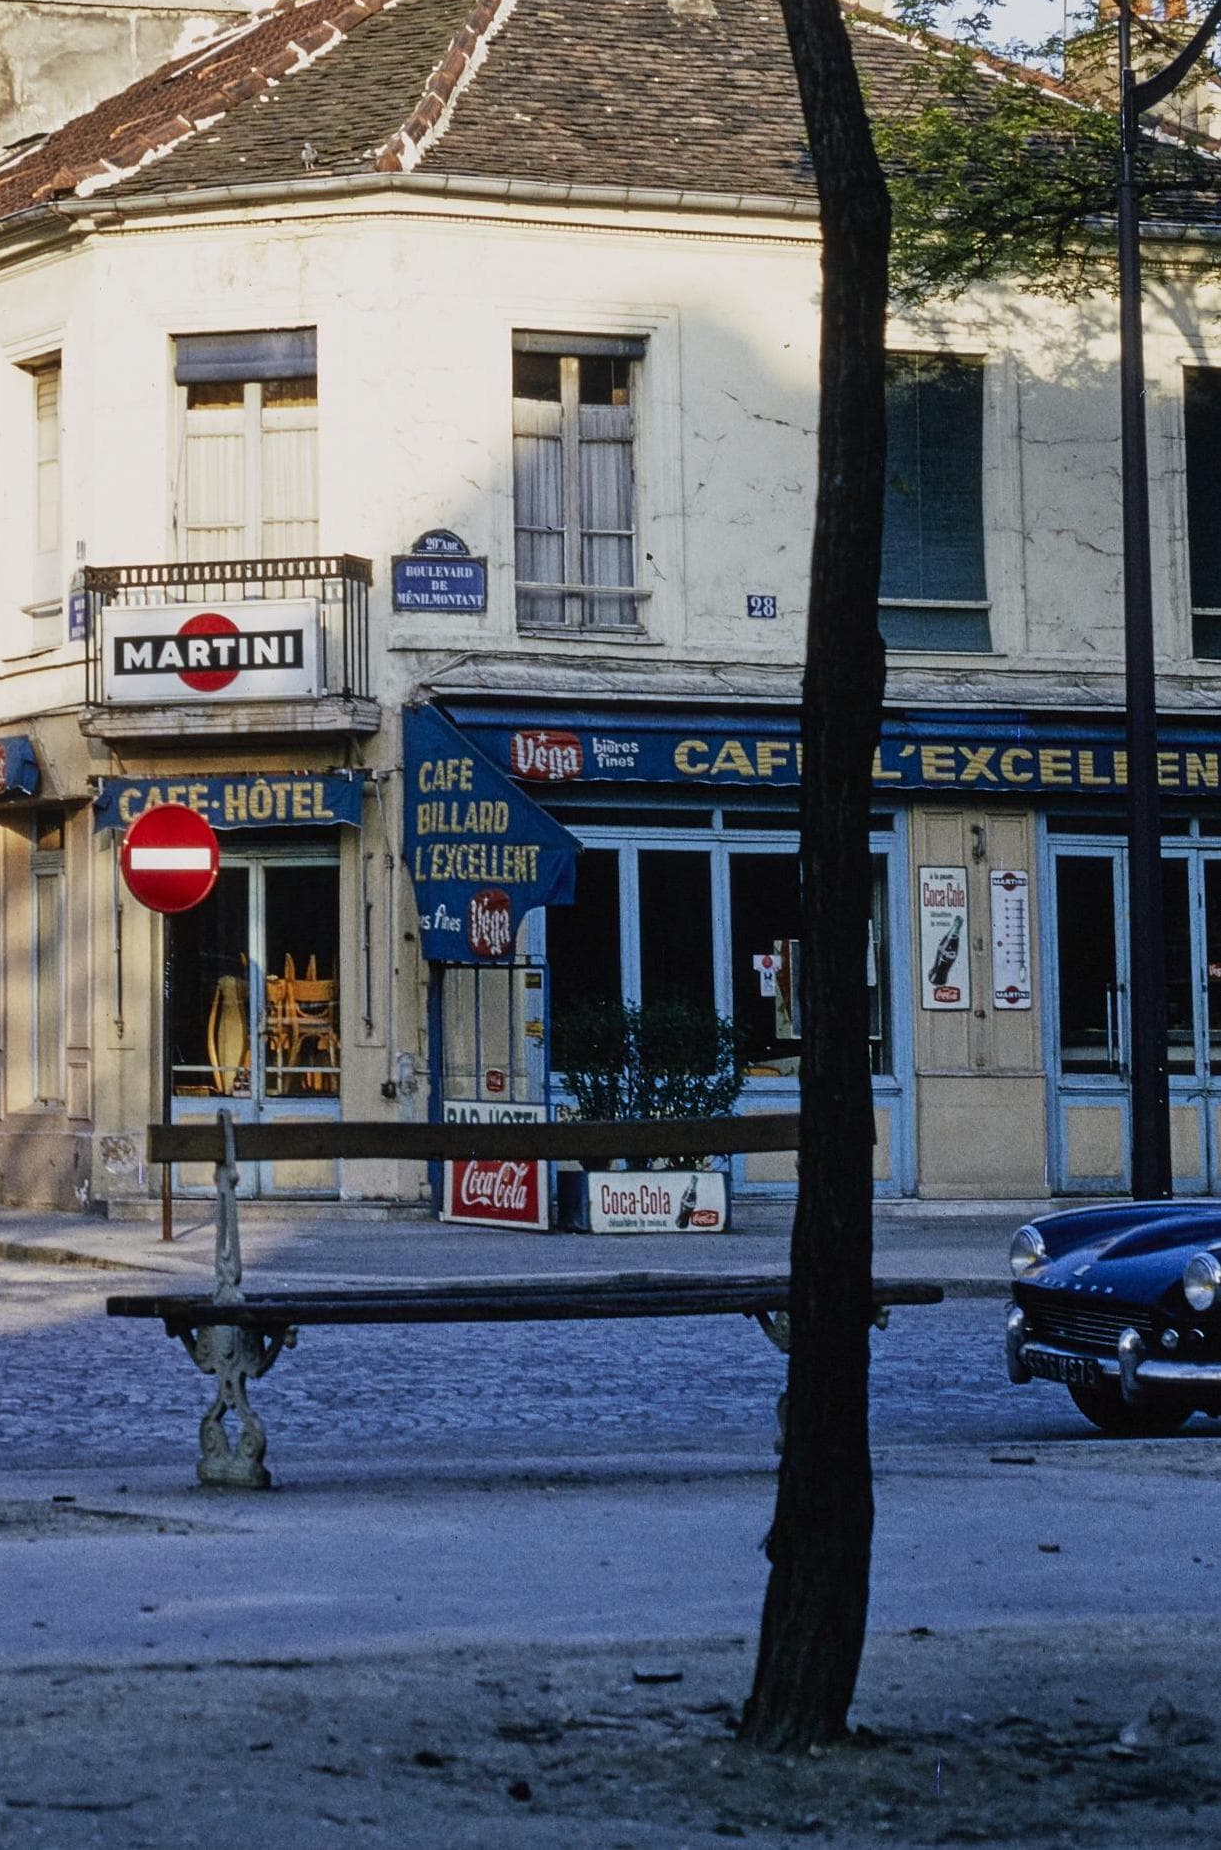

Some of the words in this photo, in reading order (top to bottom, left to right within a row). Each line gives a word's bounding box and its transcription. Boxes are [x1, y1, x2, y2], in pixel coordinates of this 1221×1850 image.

[405, 565, 473, 578] BOULEVARD
[431, 580, 448, 591] DE
[397, 590, 484, 606] MÉNILMONTANT
[750, 596, 774, 617] 28
[123, 636, 294, 670] MARTINI
[597, 753, 636, 769] fines
[674, 739, 803, 777] CAF
[417, 801, 509, 835] BILLARD
[415, 843, 540, 883] L'EXCELLENT
[923, 882, 965, 906] Coca-Cola
[434, 903, 462, 933] fines
[461, 1160, 530, 1210] Coca-Cola
[601, 1184, 671, 1215] Coca-Cola
